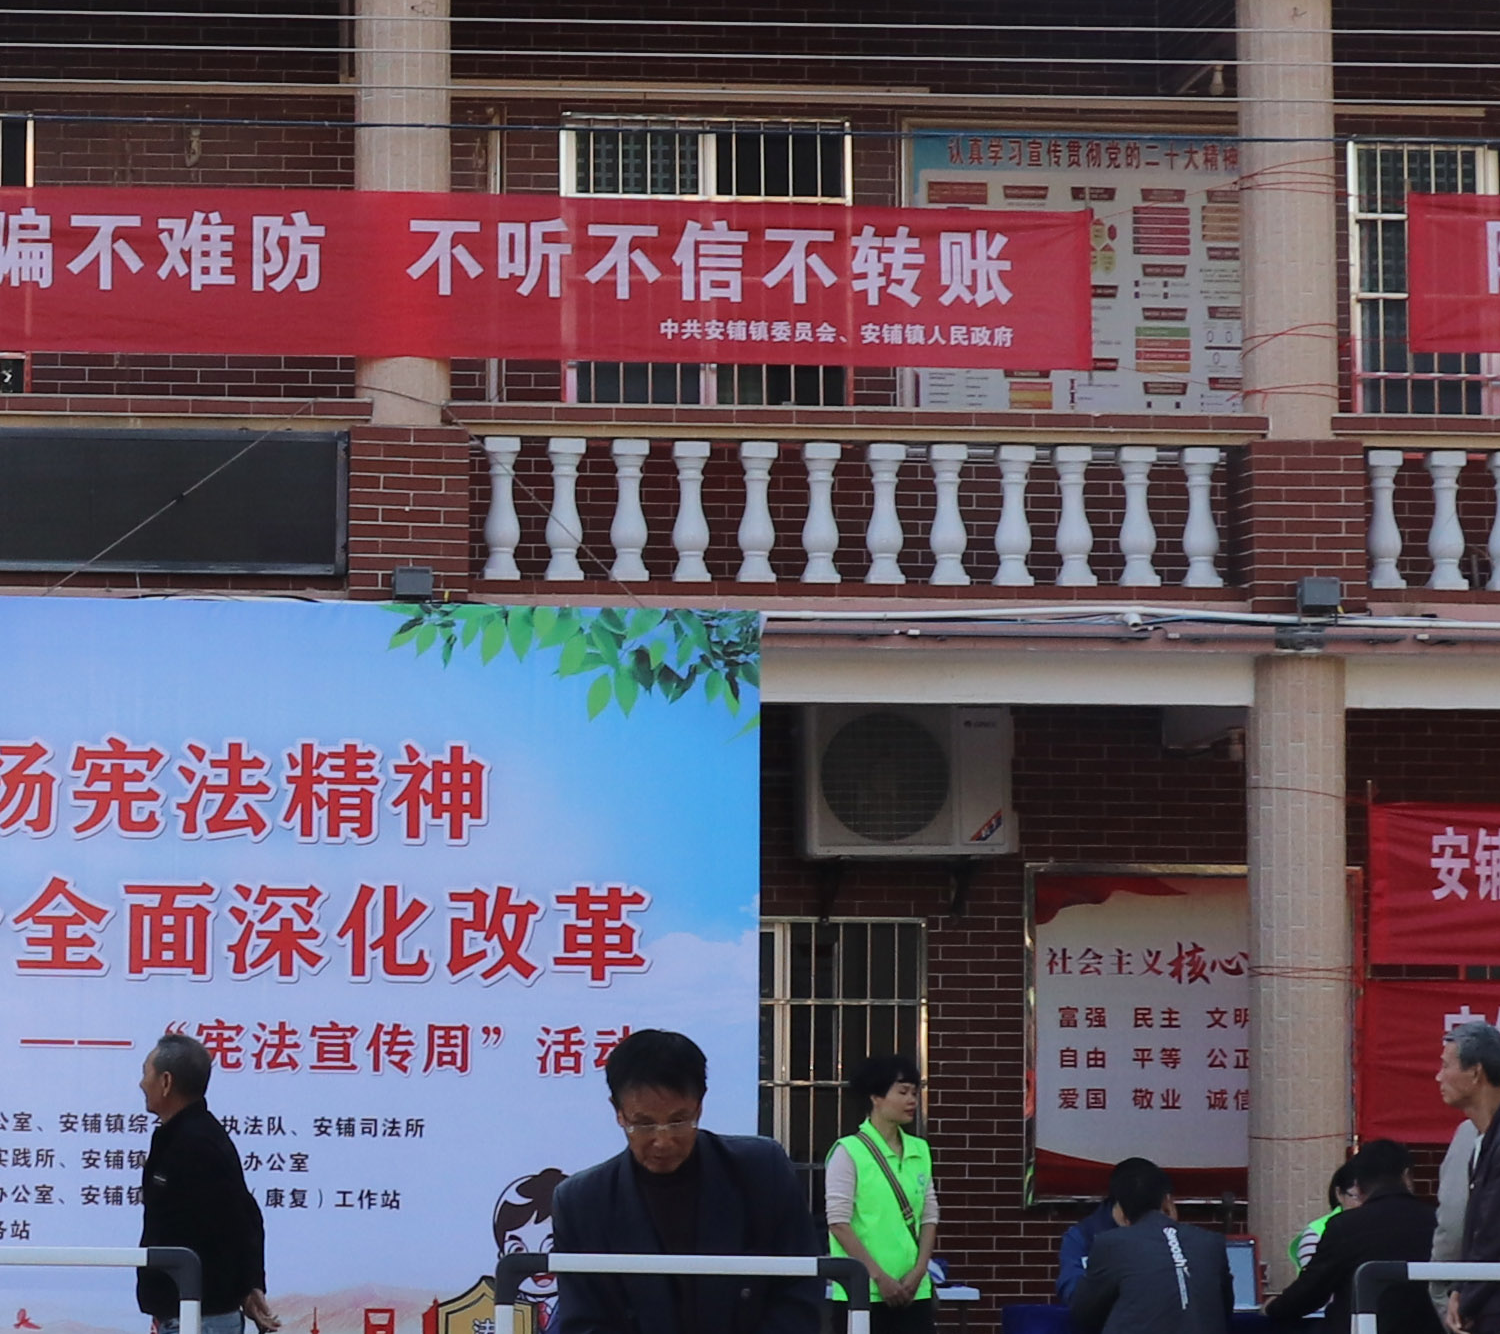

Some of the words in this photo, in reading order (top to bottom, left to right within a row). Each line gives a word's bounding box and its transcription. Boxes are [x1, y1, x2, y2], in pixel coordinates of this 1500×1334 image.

[949, 137, 1239, 172] 认真学习宣传贯彻党的二十大精神
[407, 217, 1015, 308] 不听不信不转账
[659, 317, 1015, 350] 中共安铺镇委员会、安铺镇人民政府
[1046, 941, 1249, 985] 社会主义核心
[1058, 1007, 1107, 1028] 富强
[1133, 1007, 1181, 1028] 民主
[1206, 1007, 1249, 1029] 文明
[1059, 1047, 1107, 1069] 自由
[1132, 1047, 1181, 1069] 平等
[1206, 1048, 1249, 1069] 公正
[1058, 1088, 1107, 1110] 爱国
[1132, 1088, 1181, 1110] 敬业
[1206, 1088, 1249, 1110] 诚信
